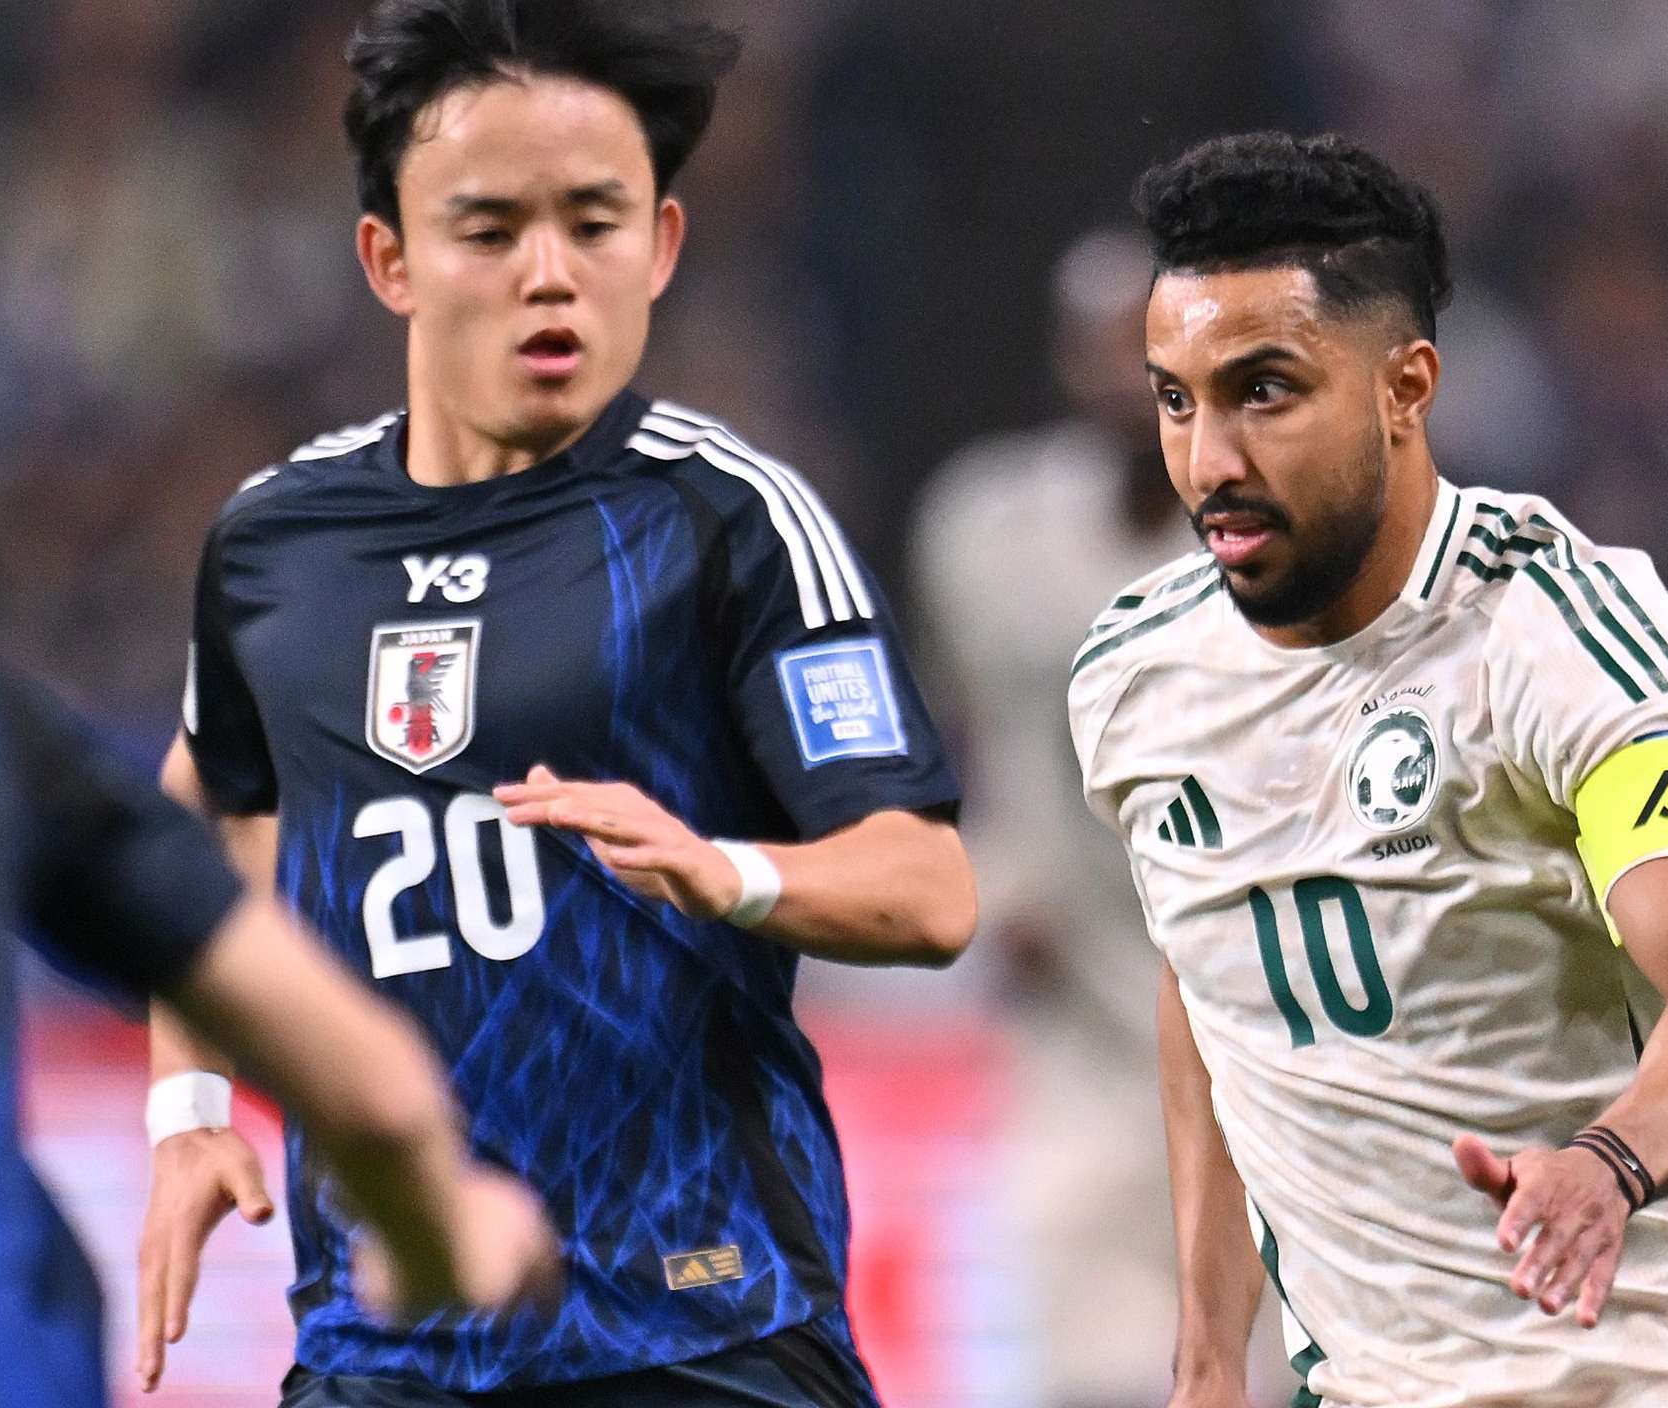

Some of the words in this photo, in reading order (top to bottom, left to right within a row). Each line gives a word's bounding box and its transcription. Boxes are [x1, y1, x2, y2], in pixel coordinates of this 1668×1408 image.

[401, 554, 491, 603] Y-3
[398, 630, 454, 646] JAPAN
[807, 678, 871, 704] UNITES
[1371, 832, 1435, 861] SAUDI
[353, 794, 547, 979] 20
[1249, 875, 1394, 1049] 10
